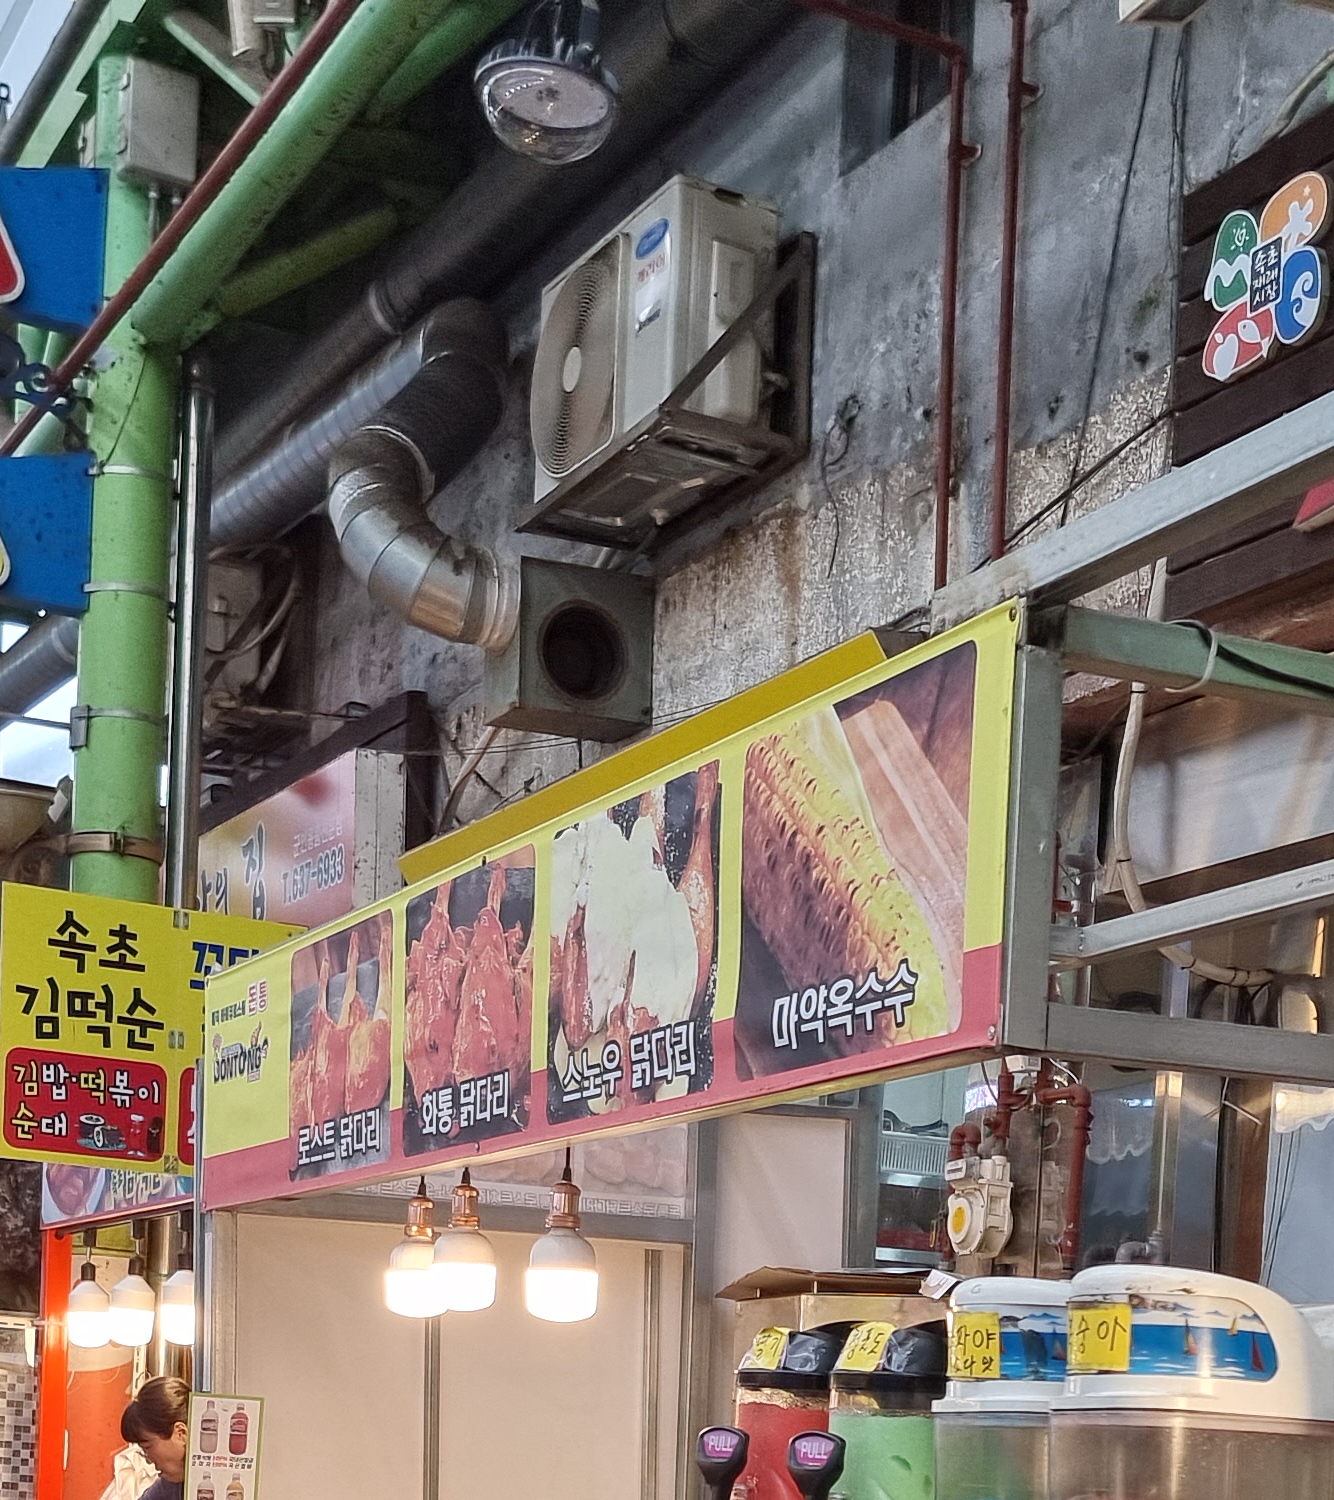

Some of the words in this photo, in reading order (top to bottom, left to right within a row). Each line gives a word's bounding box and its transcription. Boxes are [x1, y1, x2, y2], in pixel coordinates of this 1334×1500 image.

[281, 843, 345, 906] T.637-6933
[47, 909, 146, 974] 속초
[15, 976, 165, 1052] 김떡순
[771, 959, 919, 1051] 마약옥수수
[562, 1043, 622, 1104] 스노우
[629, 1020, 697, 1090] 닭다리
[11, 1102, 68, 1141] 순대
[420, 1088, 454, 1137] 화통
[458, 1070, 511, 1127] 닭다리
[296, 1125, 336, 1167] 로스트
[338, 1107, 382, 1158] 닭다리
[707, 1435, 734, 1453] PULL
[799, 1441, 828, 1461] PULL
